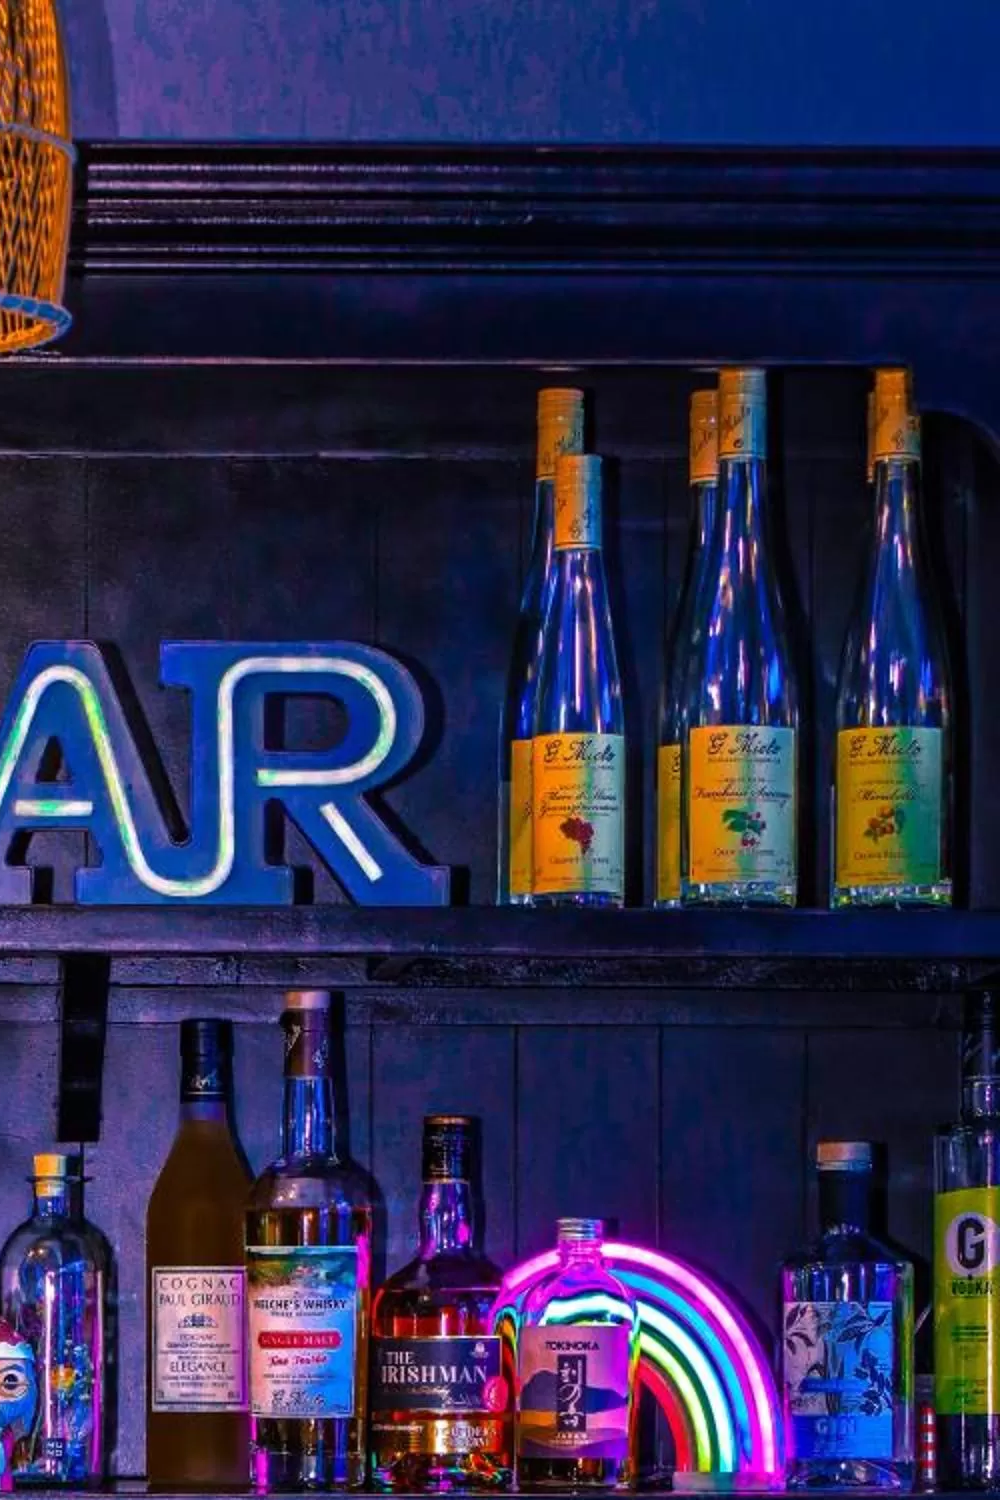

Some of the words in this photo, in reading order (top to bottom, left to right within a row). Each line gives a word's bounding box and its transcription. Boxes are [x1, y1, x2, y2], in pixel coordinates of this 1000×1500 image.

[957, 1217, 985, 1270] G
[159, 1277, 240, 1290] COGNAC
[159, 1293, 187, 1306] PAUL
[190, 1293, 240, 1306] GIRAUD
[304, 1299, 346, 1310] WHISKY
[545, 1341, 600, 1351] TOKINOKA
[385, 1351, 415, 1365] THE
[381, 1365, 488, 1384] IRISHMAN
